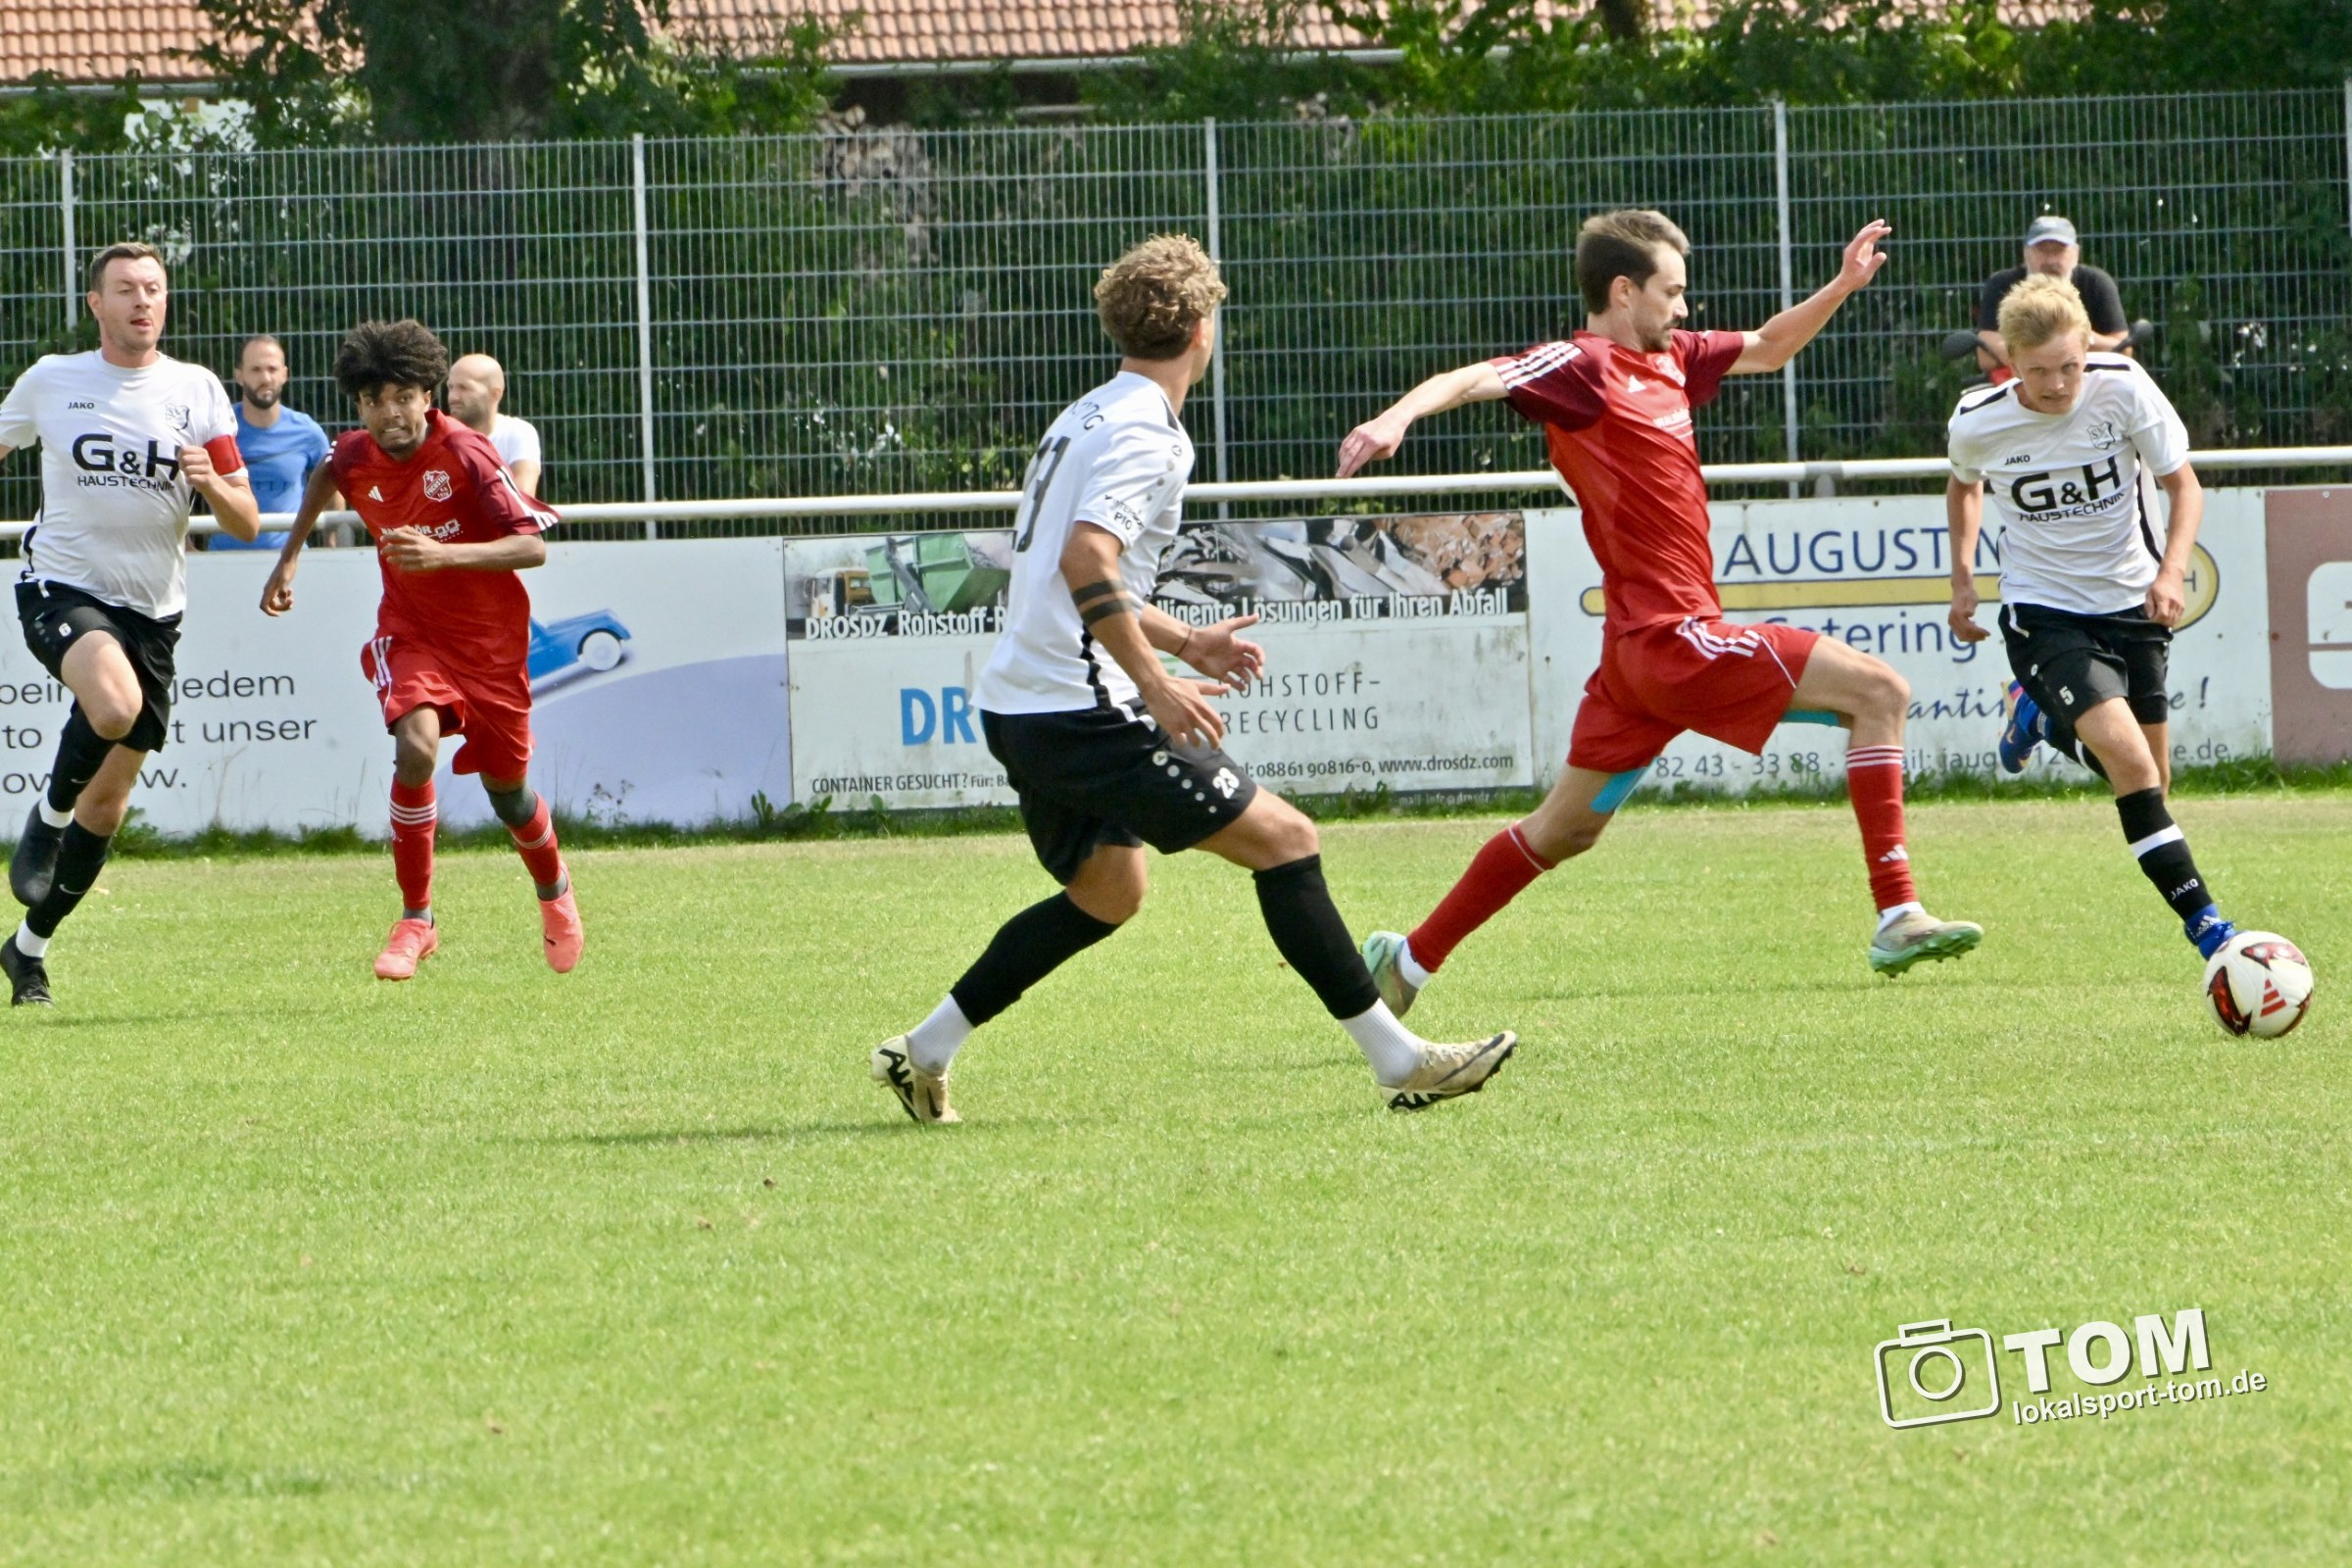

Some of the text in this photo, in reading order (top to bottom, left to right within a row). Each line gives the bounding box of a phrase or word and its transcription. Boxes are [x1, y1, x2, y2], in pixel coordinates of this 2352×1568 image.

[73, 433, 180, 481] G&H
[2004, 455, 2031, 466] JAKO
[2011, 455, 2121, 513] G&H
[1723, 525, 2006, 576] AUGUSTN
[806, 615, 889, 640] DROSDZ
[898, 605, 1007, 637] Rohstoff-R
[1349, 592, 1383, 620] für
[1389, 592, 1445, 618] Ihren
[1448, 588, 1508, 615] Abfall
[2059, 686, 2075, 706] 5
[202, 718, 318, 744] unser
[1220, 707, 1379, 735] RECYCLING
[1378, 754, 1514, 773] www.drosdz.com
[1694, 754, 1724, 776] 43
[811, 775, 893, 794] CONTAINER
[2171, 878, 2198, 900] JAKO
